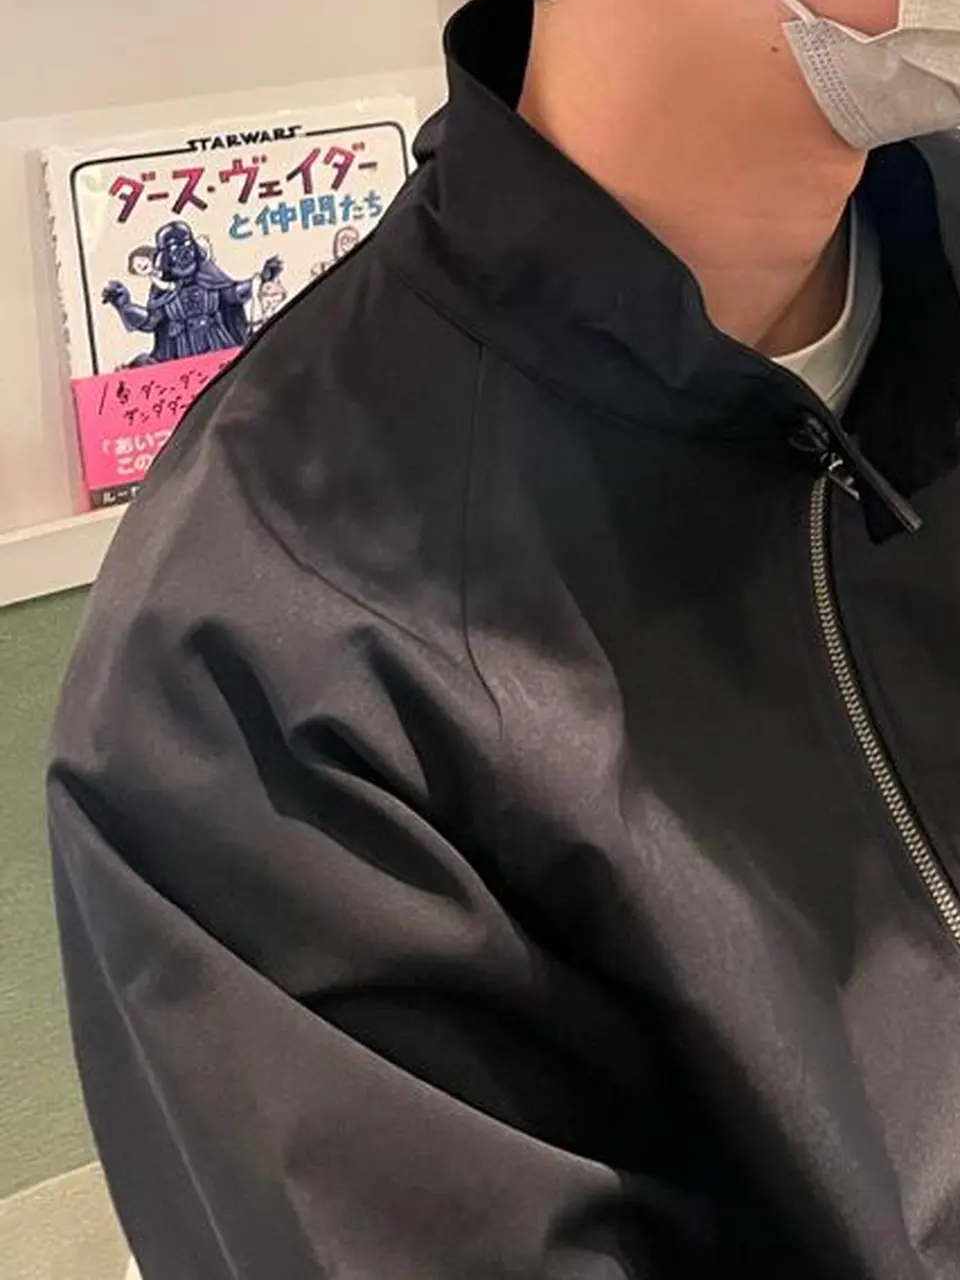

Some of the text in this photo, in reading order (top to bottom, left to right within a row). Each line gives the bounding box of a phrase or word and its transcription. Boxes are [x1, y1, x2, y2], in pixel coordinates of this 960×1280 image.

[108, 141, 378, 224] ダース・ヴェイダー
[229, 190, 384, 241] と仲間たち
